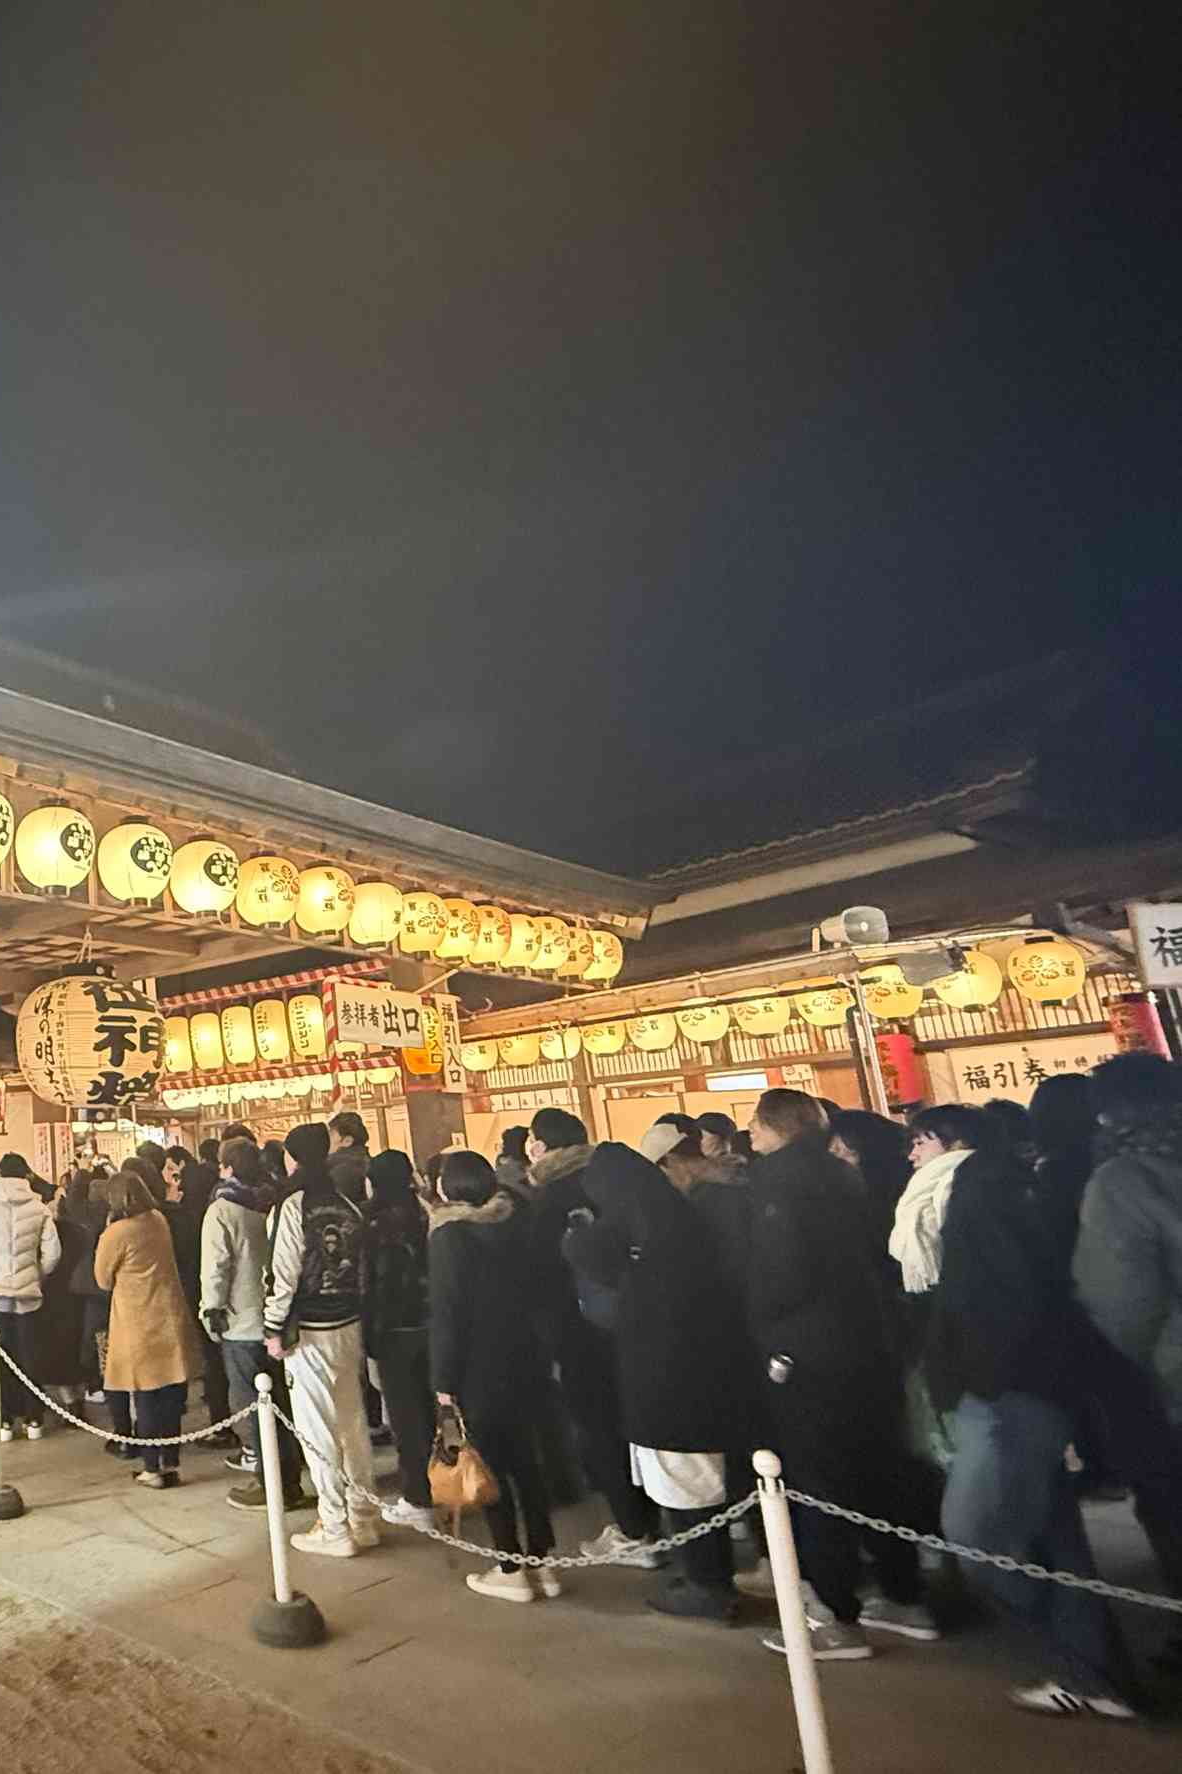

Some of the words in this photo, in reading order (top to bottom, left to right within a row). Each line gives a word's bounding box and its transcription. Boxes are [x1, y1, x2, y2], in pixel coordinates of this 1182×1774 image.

[339, 998, 420, 1038] 参拝者出口
[440, 1003, 462, 1084] 福引入口
